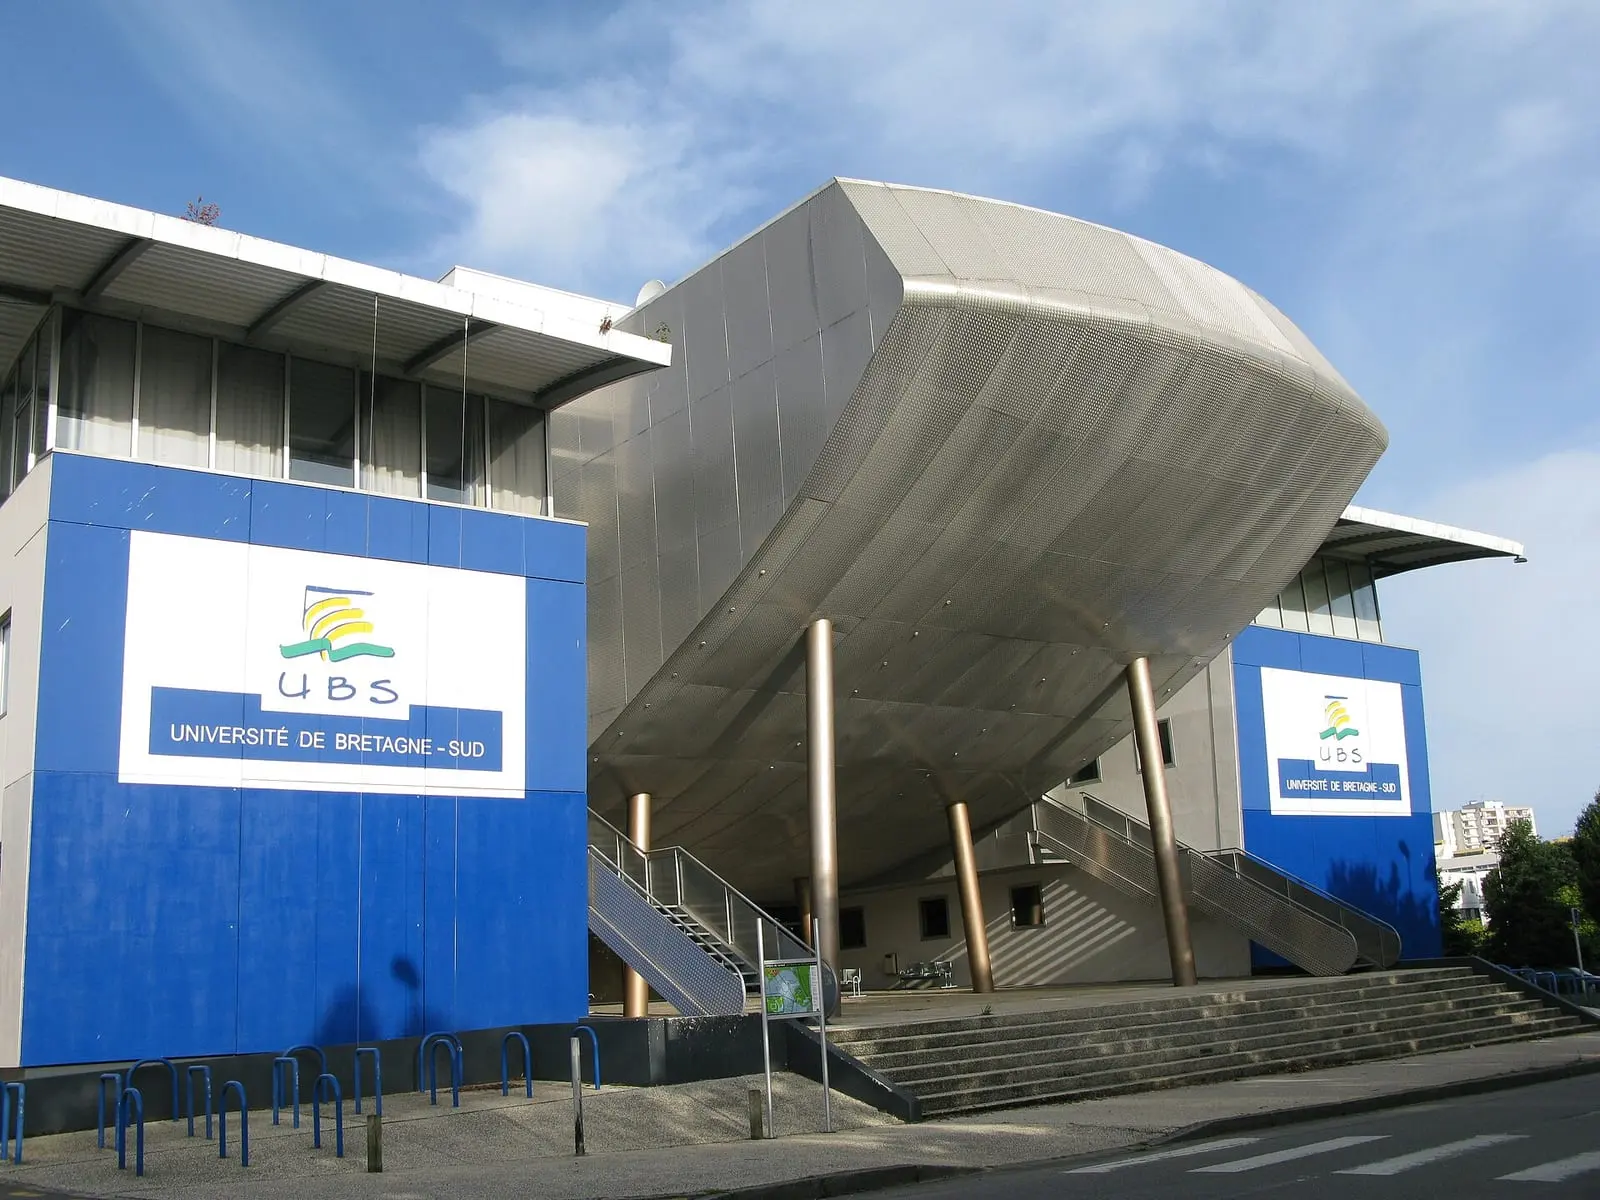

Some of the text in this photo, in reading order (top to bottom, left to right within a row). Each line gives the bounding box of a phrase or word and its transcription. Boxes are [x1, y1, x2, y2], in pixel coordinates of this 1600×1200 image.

[278, 671, 399, 705] UBS
[170, 723, 289, 746] UNIVERSITÉ
[299, 731, 326, 749] DE
[1319, 747, 1363, 763] UBS
[1286, 778, 1328, 791] UNIVERSITÉ
[1330, 782, 1340, 791] DE
